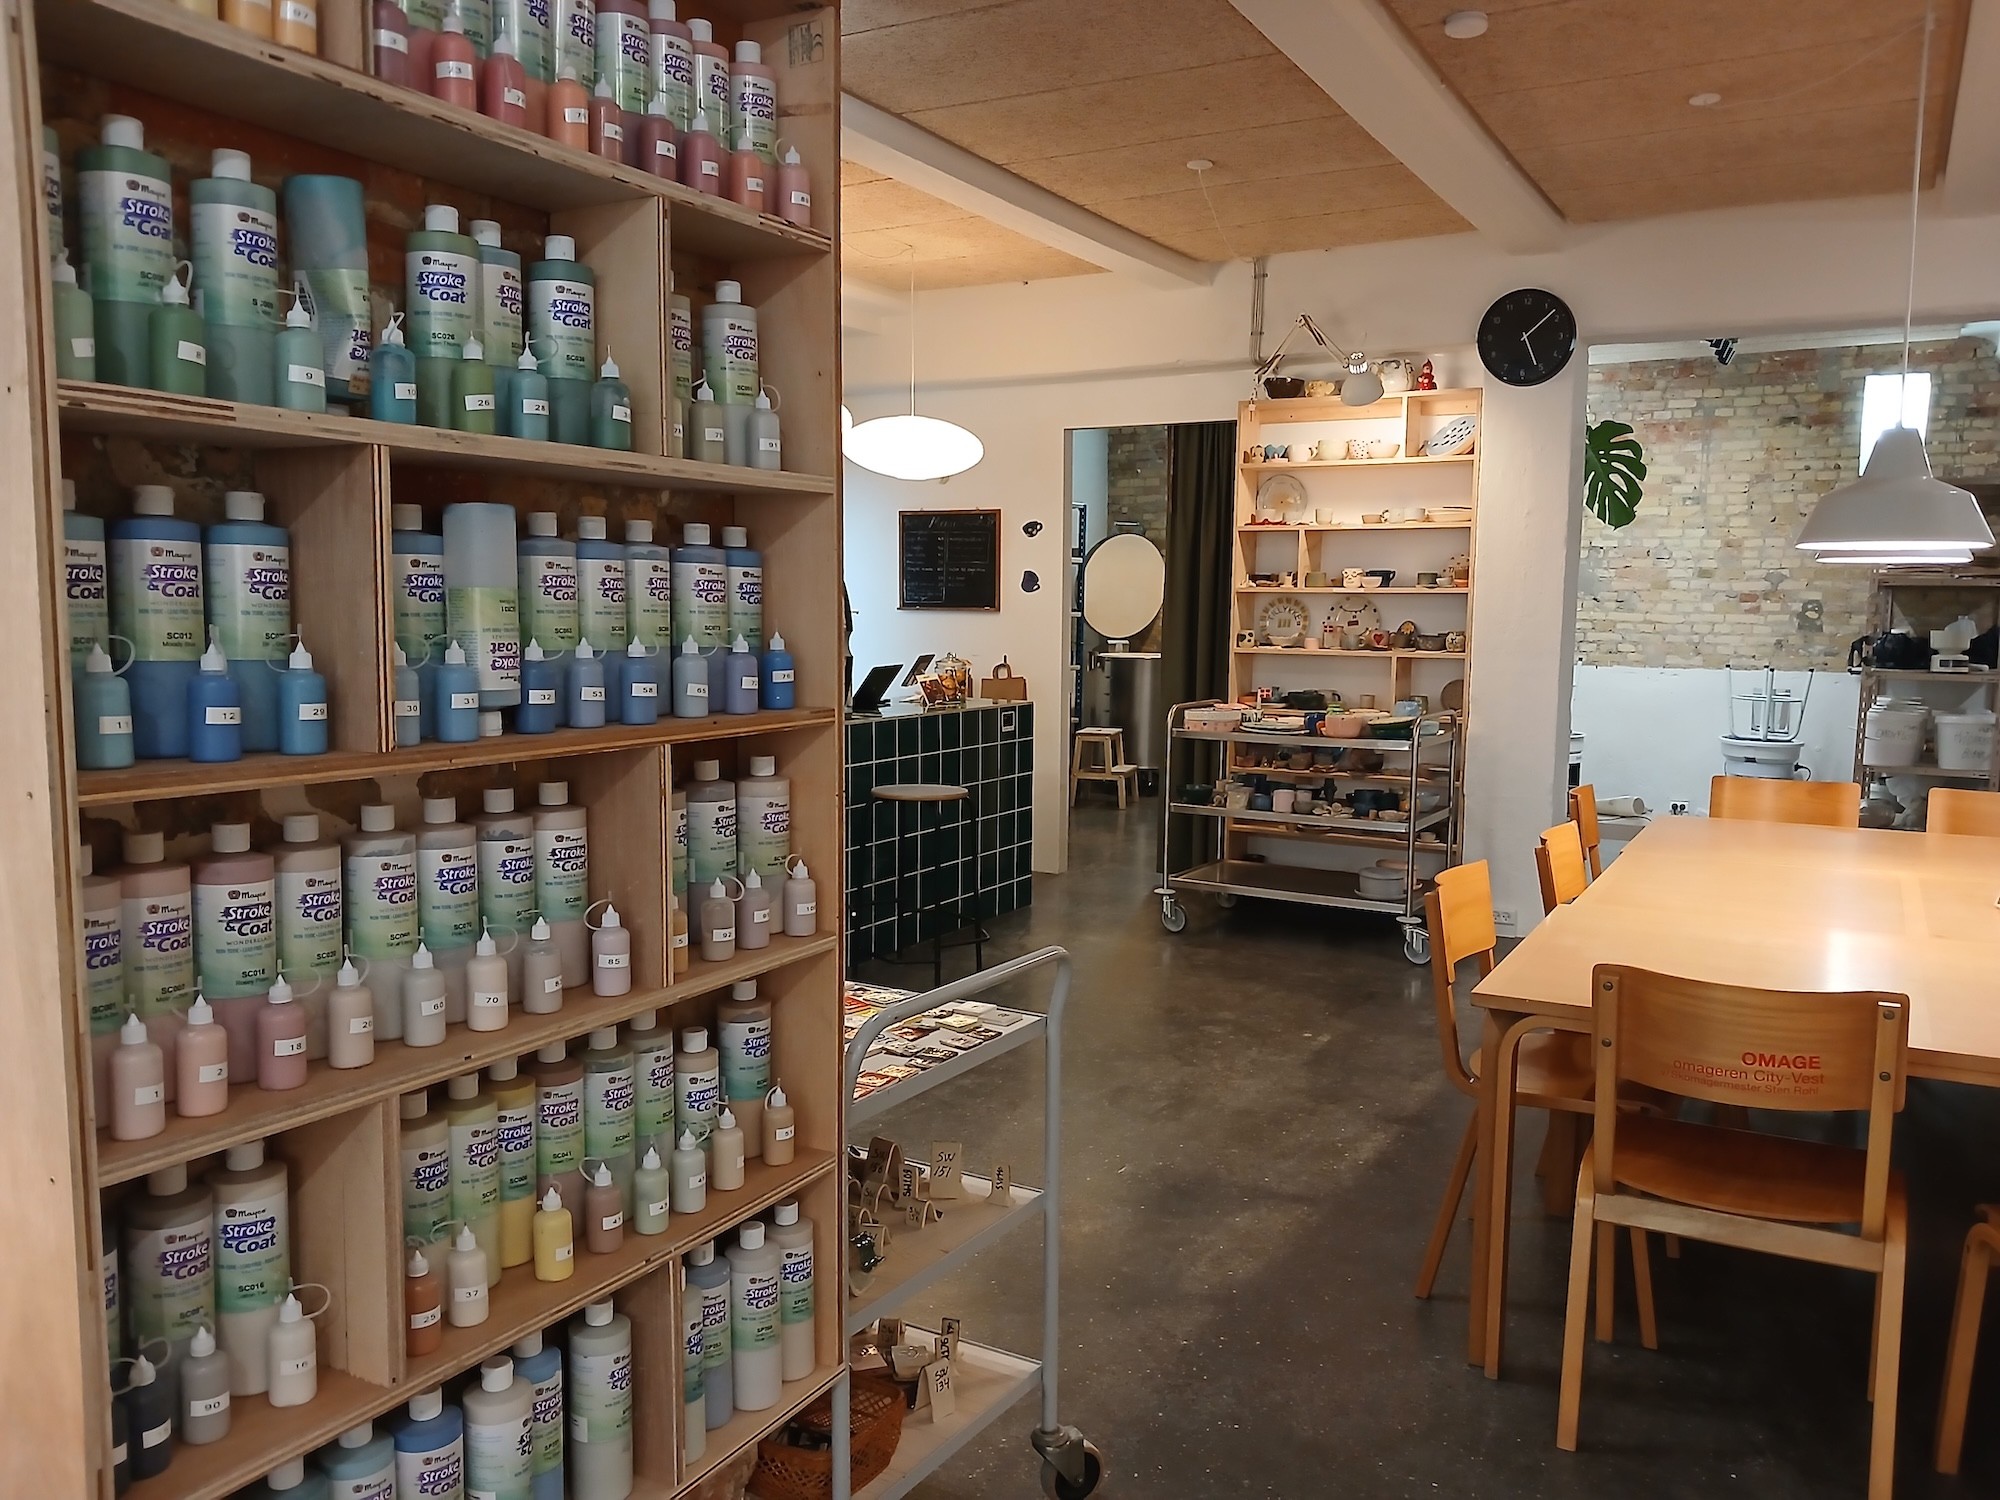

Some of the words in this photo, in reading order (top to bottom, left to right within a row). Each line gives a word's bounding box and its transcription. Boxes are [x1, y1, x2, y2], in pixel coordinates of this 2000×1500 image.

[625, 34, 649, 50] Stro
[742, 93, 773, 107] Stroke
[127, 200, 170, 221] Stroke
[237, 231, 276, 251] Stroke
[421, 272, 463, 287] Stroke
[428, 287, 466, 304] Coat
[503, 286, 521, 301] Stro
[555, 300, 590, 314] Stroke
[562, 314, 591, 329] Coat
[151, 565, 198, 580] Stroke
[252, 570, 288, 584] Stroke
[410, 574, 443, 587] Stroke
[545, 575, 576, 587] Stroke
[604, 578, 625, 589] Stro
[652, 578, 670, 588] Stro
[67, 583, 104, 600] Coat
[161, 582, 200, 599] Coat
[222, 712, 236, 720] 12
[313, 708, 325, 716] 29
[555, 846, 586, 859] Stroke
[442, 865, 476, 880] Stroke
[379, 873, 415, 889] Stroke
[304, 890, 340, 906] Stroke
[229, 904, 271, 920] Stroke
[147, 917, 189, 935] Stroke
[238, 920, 272, 936] Coat
[433, 1001, 444, 1010] 60
[290, 1042, 302, 1051] 18
[1742, 1052, 1821, 1069] OMAGE
[217, 1068, 223, 1076] 2
[654, 1063, 674, 1078] Stro
[1673, 1060, 1748, 1079] omageren
[1754, 1070, 1824, 1085] City-Vest
[1765, 1084, 1790, 1094] Sten
[542, 1100, 578, 1114] Stroke
[550, 1113, 579, 1128] Coat
[498, 1123, 531, 1139] Stroke
[504, 1137, 533, 1152] Coat
[936, 1151, 956, 1162] SW
[934, 1166, 951, 1177] 151
[225, 1219, 273, 1239] Stroke
[235, 1235, 277, 1255] Coat
[163, 1242, 209, 1266] Stroke
[785, 1257, 812, 1272] Stroke
[465, 1289, 478, 1298] 37
[750, 1282, 778, 1298] Stroke
[423, 1313, 436, 1323] 25
[936, 1378, 949, 1392] 134
[204, 1401, 221, 1410] 90
[422, 1458, 461, 1484] Stroke
